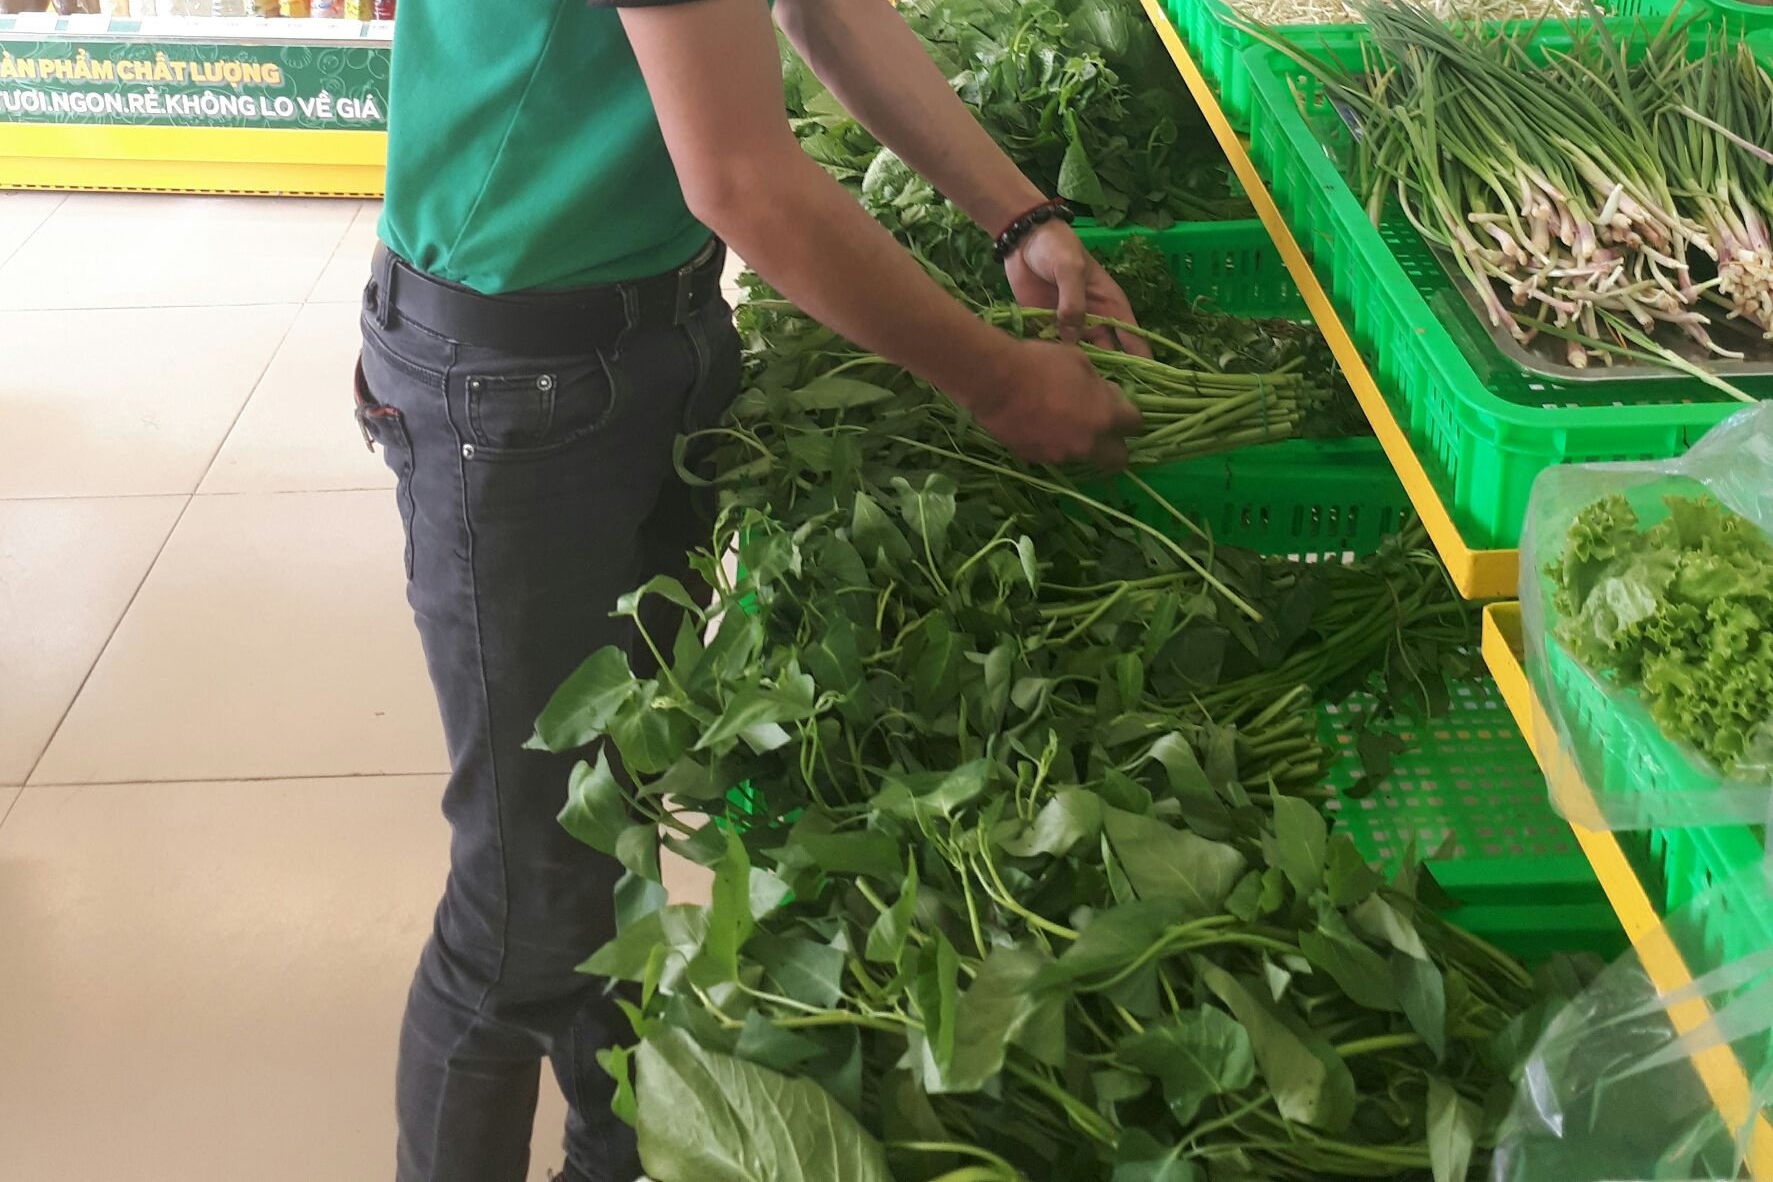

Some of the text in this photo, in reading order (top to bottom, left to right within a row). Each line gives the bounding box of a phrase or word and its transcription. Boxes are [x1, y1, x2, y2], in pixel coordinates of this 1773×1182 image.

[40, 47, 114, 81] PHẨM
[116, 50, 192, 85] CHẤT
[191, 59, 281, 90] LƯỢNG
[260, 95, 294, 118] LO
[296, 89, 333, 119] VỀ
[335, 92, 382, 120] GIÁ
